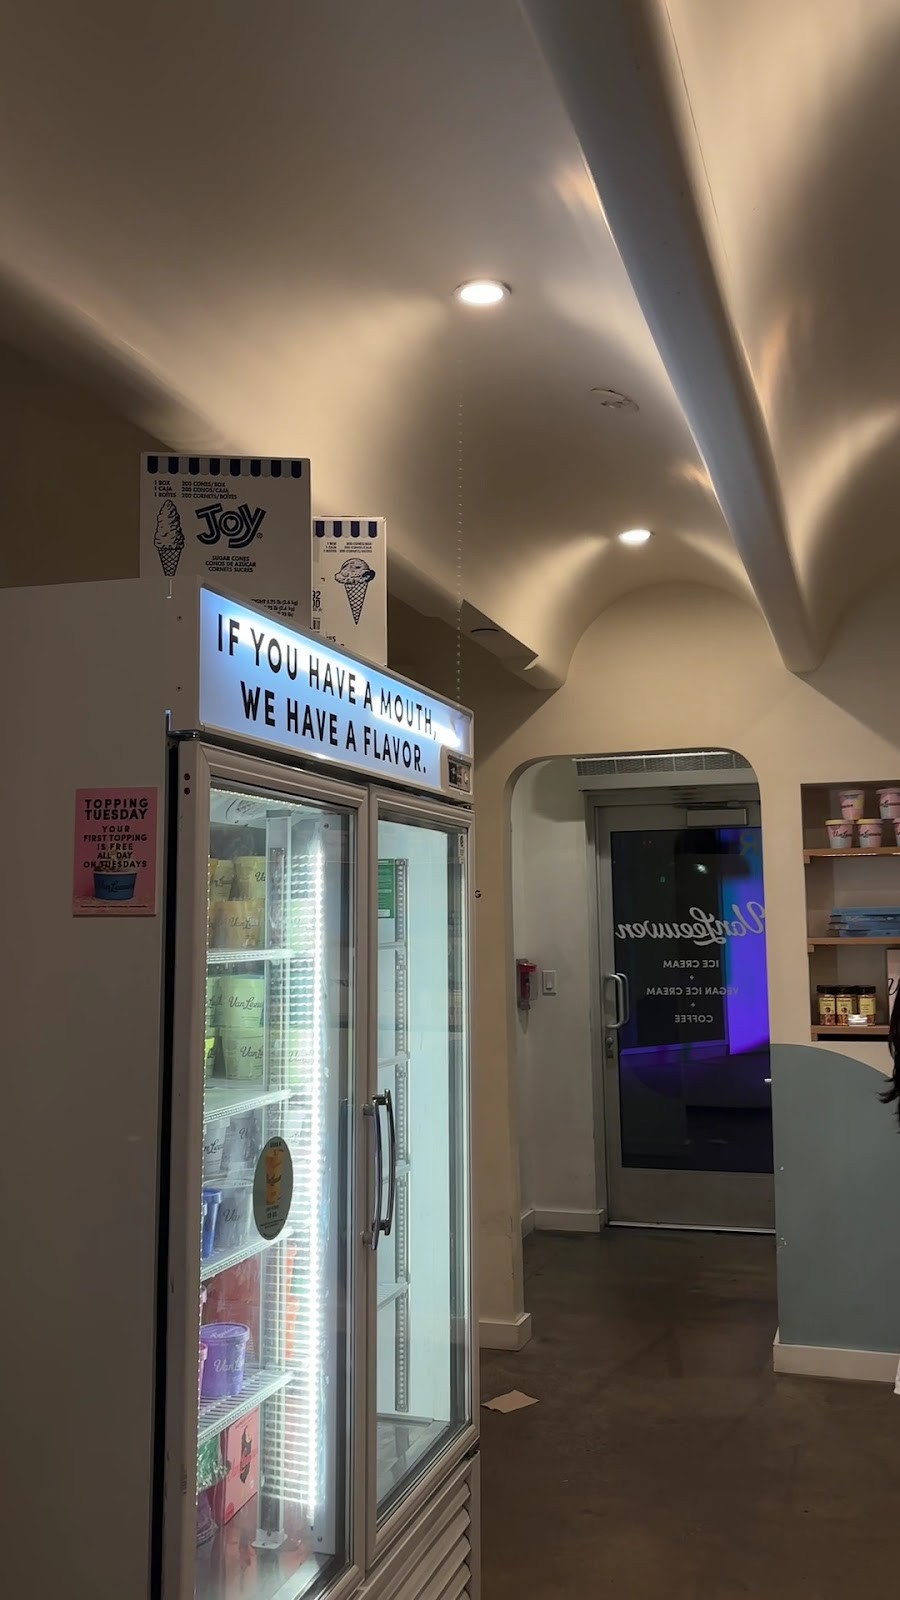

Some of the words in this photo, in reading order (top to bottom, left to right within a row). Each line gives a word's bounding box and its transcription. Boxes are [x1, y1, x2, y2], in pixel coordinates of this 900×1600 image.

[217, 613, 240, 656] IF
[250, 627, 298, 681] YOU
[309, 654, 356, 705] HAVE
[363, 681, 374, 712] A
[380, 687, 437, 741] MOUTH,
[240, 680, 276, 727] WE
[286, 697, 338, 747] HAVE
[345, 720, 357, 752] A
[363, 726, 427, 774] FLAVOR.
[84, 797, 149, 809] TOPPING
[84, 808, 149, 820] TUESDAY
[101, 825, 131, 833] YOUR
[83, 834, 107, 842] FIRST
[109, 833, 148, 841] TOPPING
[96, 843, 106, 851] IS
[109, 842, 134, 851] FREE
[96, 851, 112, 860] ALL
[116, 851, 133, 859] DAY
[99, 860, 148, 868] TUESDAYS
